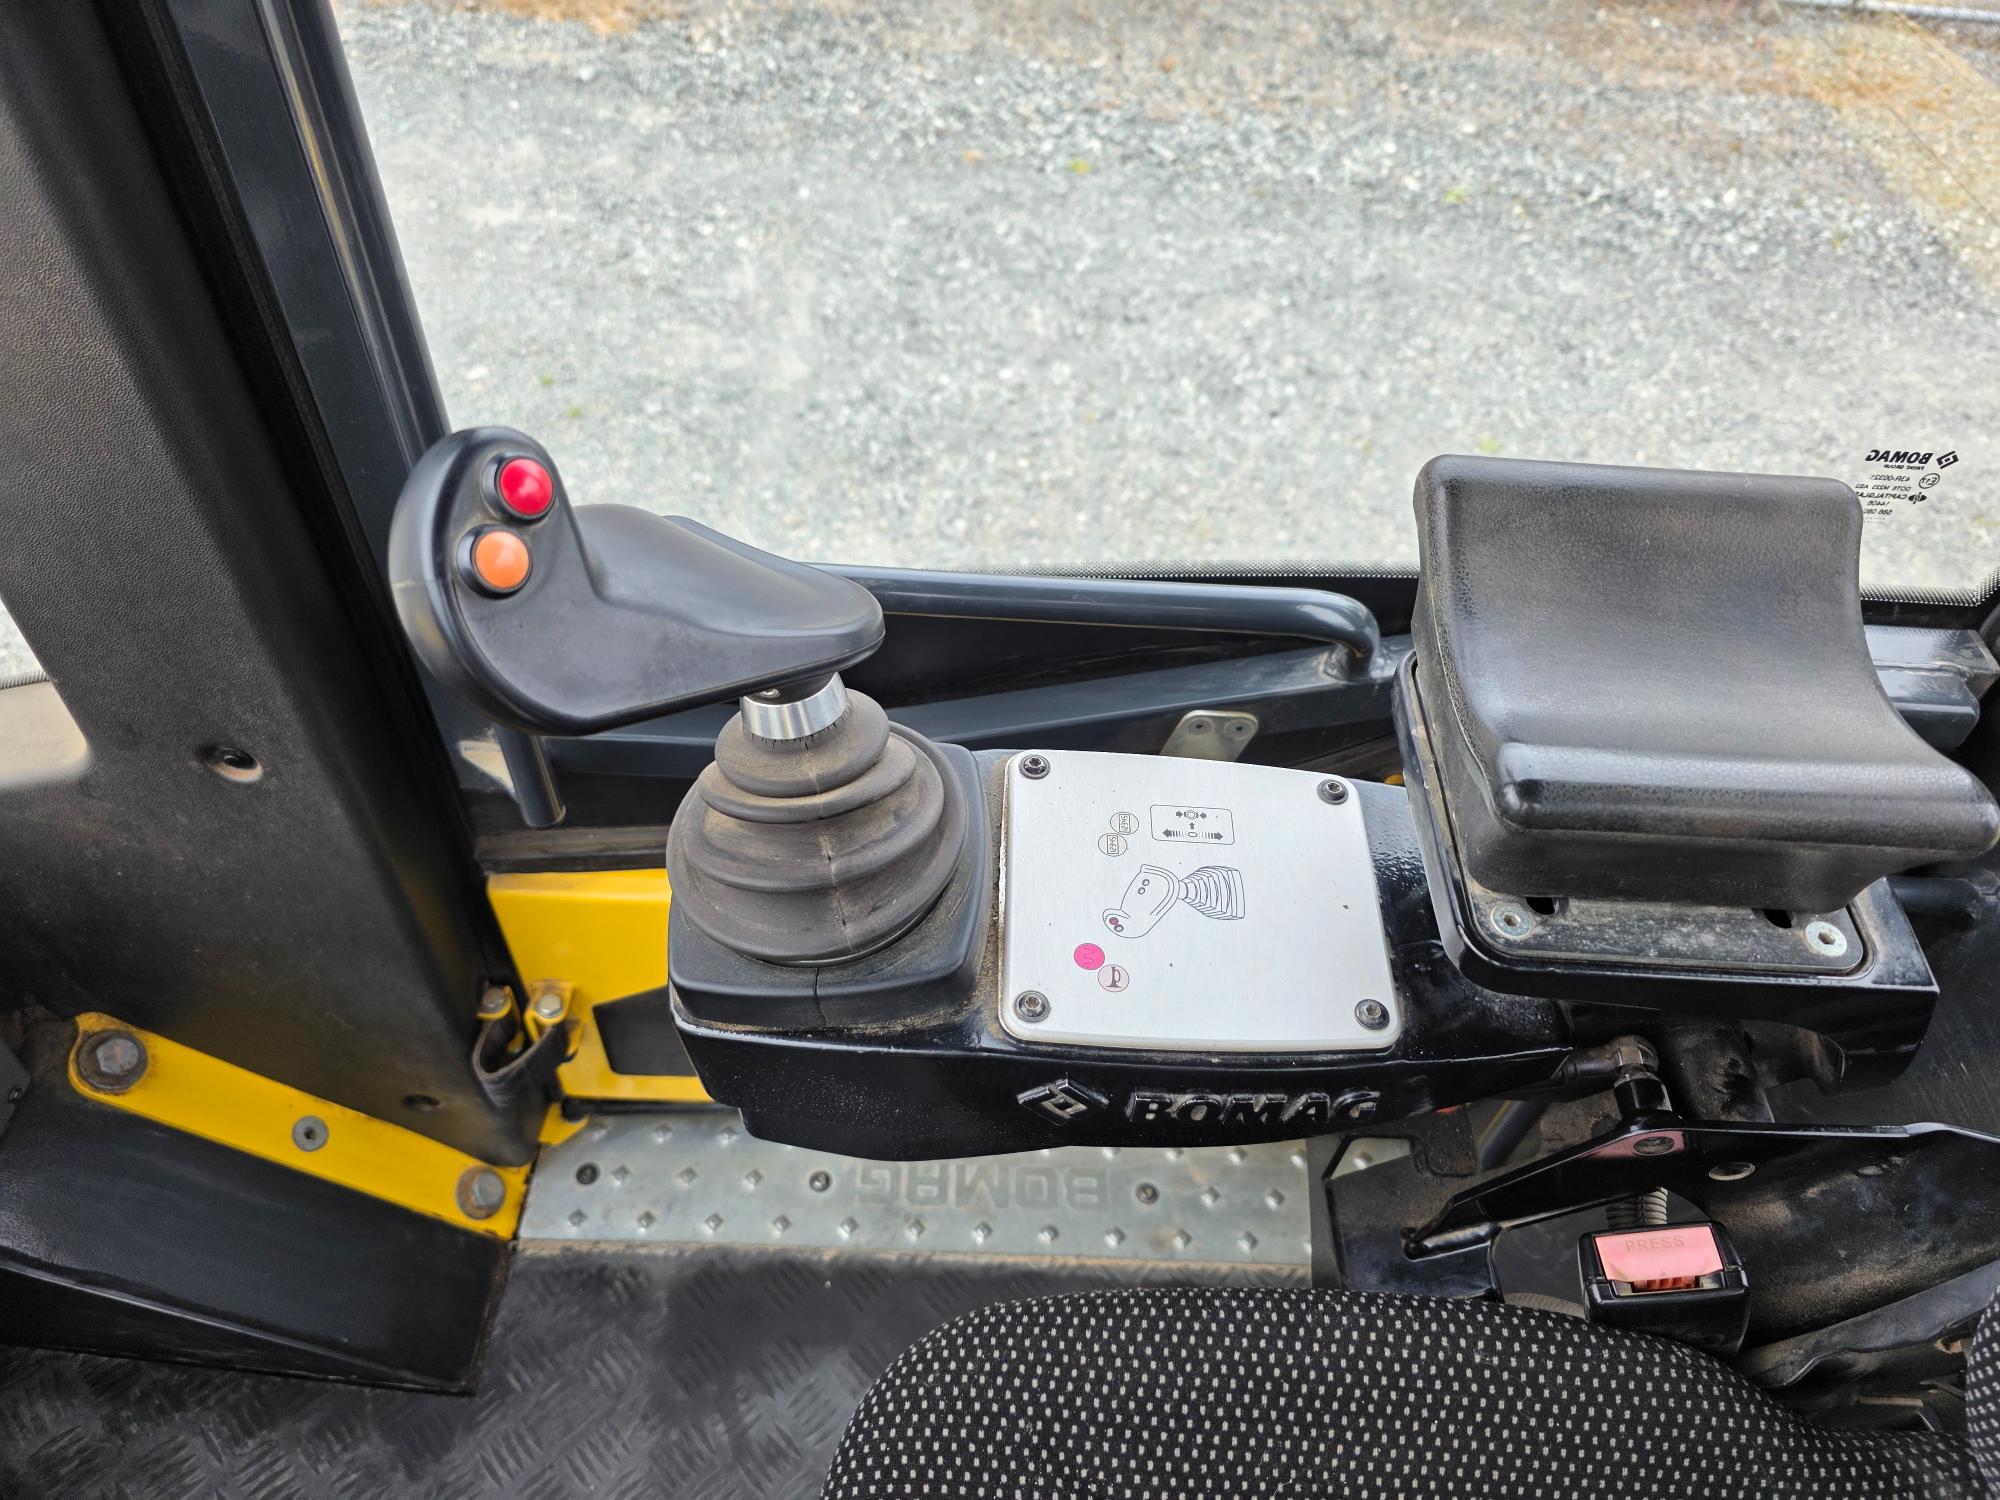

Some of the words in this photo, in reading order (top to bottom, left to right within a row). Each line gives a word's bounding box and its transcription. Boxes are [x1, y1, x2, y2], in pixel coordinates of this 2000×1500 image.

[1125, 1090, 1381, 1125] BOMAG
[857, 1162, 1111, 1210] BOMAG
[1625, 1235, 1684, 1252] PRESS
